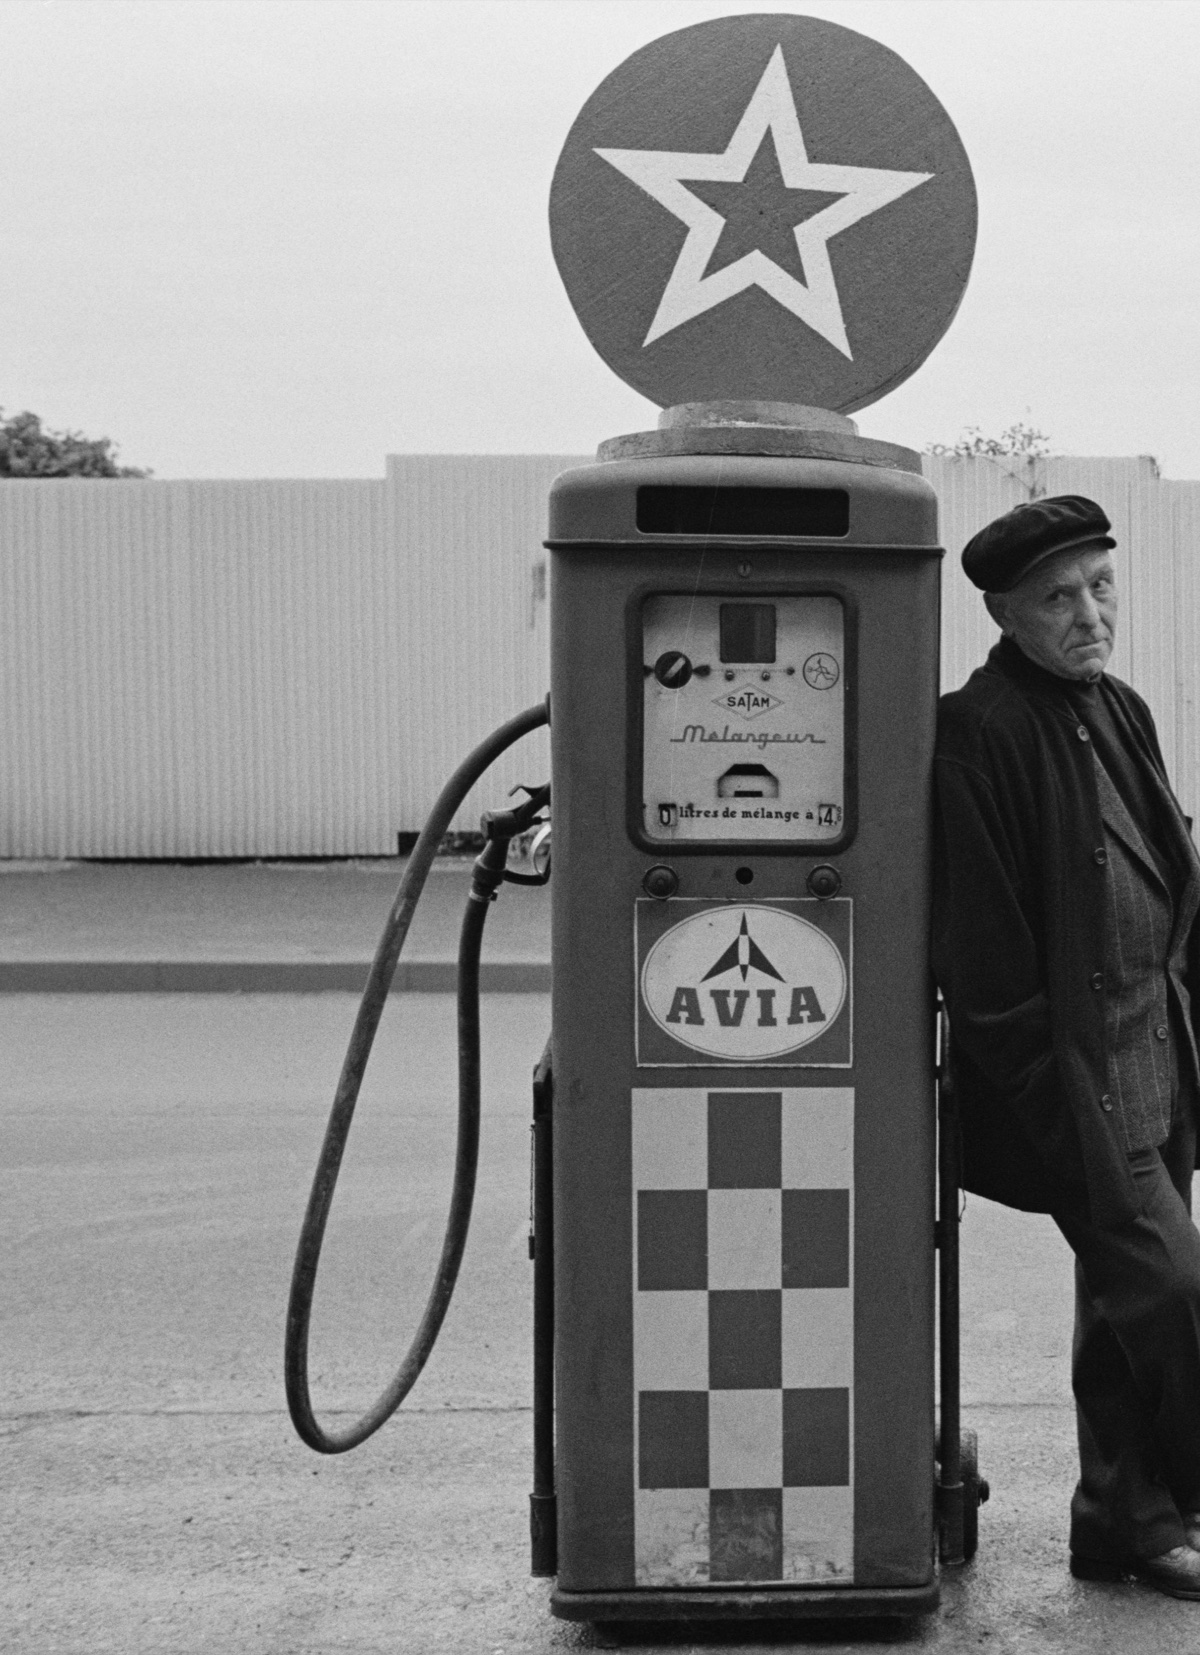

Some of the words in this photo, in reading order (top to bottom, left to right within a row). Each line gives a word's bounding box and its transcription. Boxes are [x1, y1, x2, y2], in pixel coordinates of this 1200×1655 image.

[727, 692, 770, 711] SATAM
[679, 806, 718, 818] litres
[722, 807, 737, 818] de
[741, 807, 799, 822] mélange
[805, 808, 814, 820] à
[665, 986, 827, 1028] AVIA
